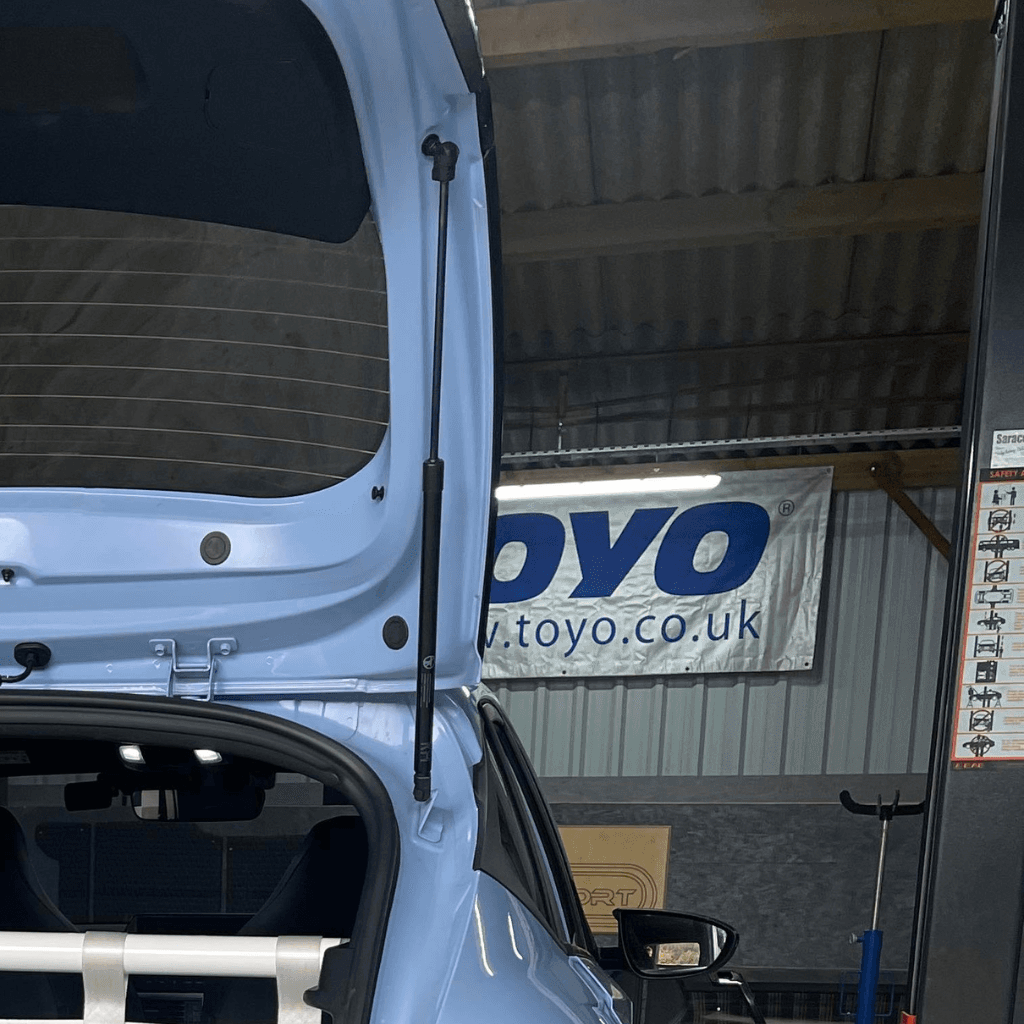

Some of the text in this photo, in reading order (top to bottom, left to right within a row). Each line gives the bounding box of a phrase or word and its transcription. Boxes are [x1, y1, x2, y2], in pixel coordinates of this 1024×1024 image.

[996, 433, 1024, 445] Sarac
[489, 501, 771, 604] OYO
[577, 888, 638, 906] ORT
